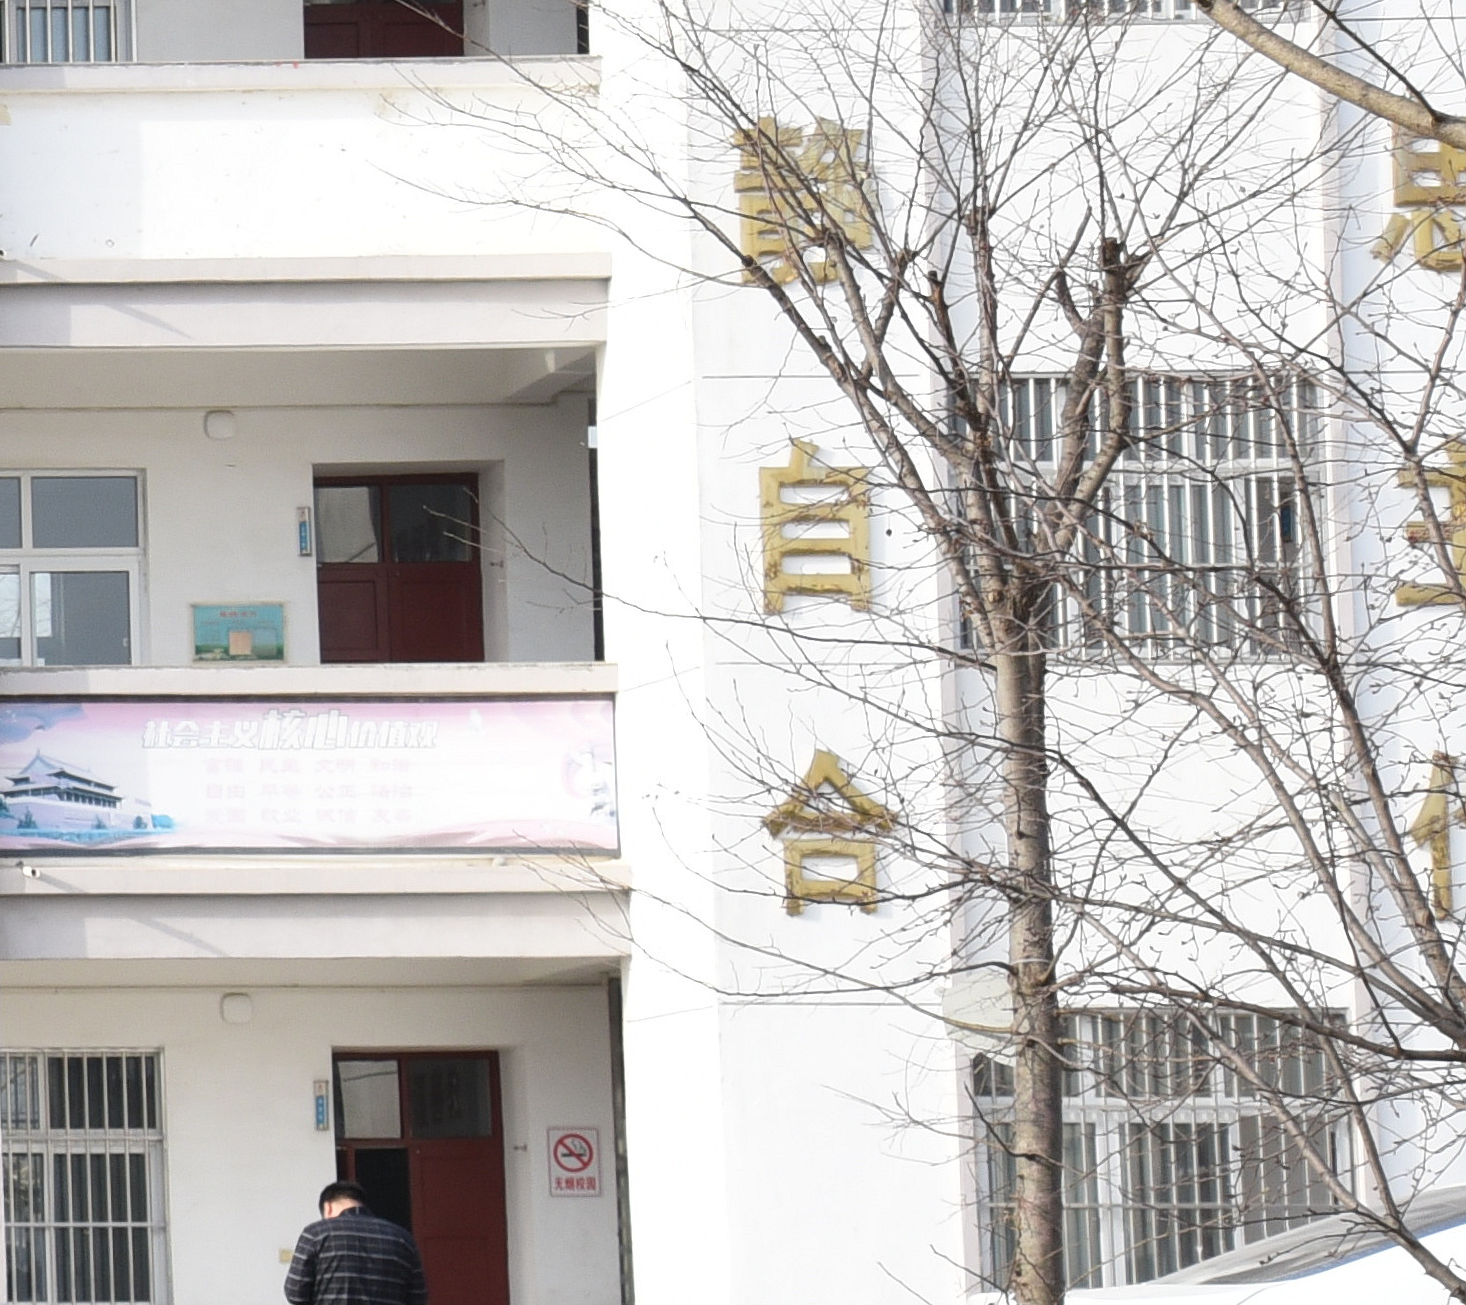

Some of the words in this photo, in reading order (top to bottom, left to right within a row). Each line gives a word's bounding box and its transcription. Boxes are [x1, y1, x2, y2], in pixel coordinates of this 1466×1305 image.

[142, 709, 439, 751] 社会主义核心价值观
